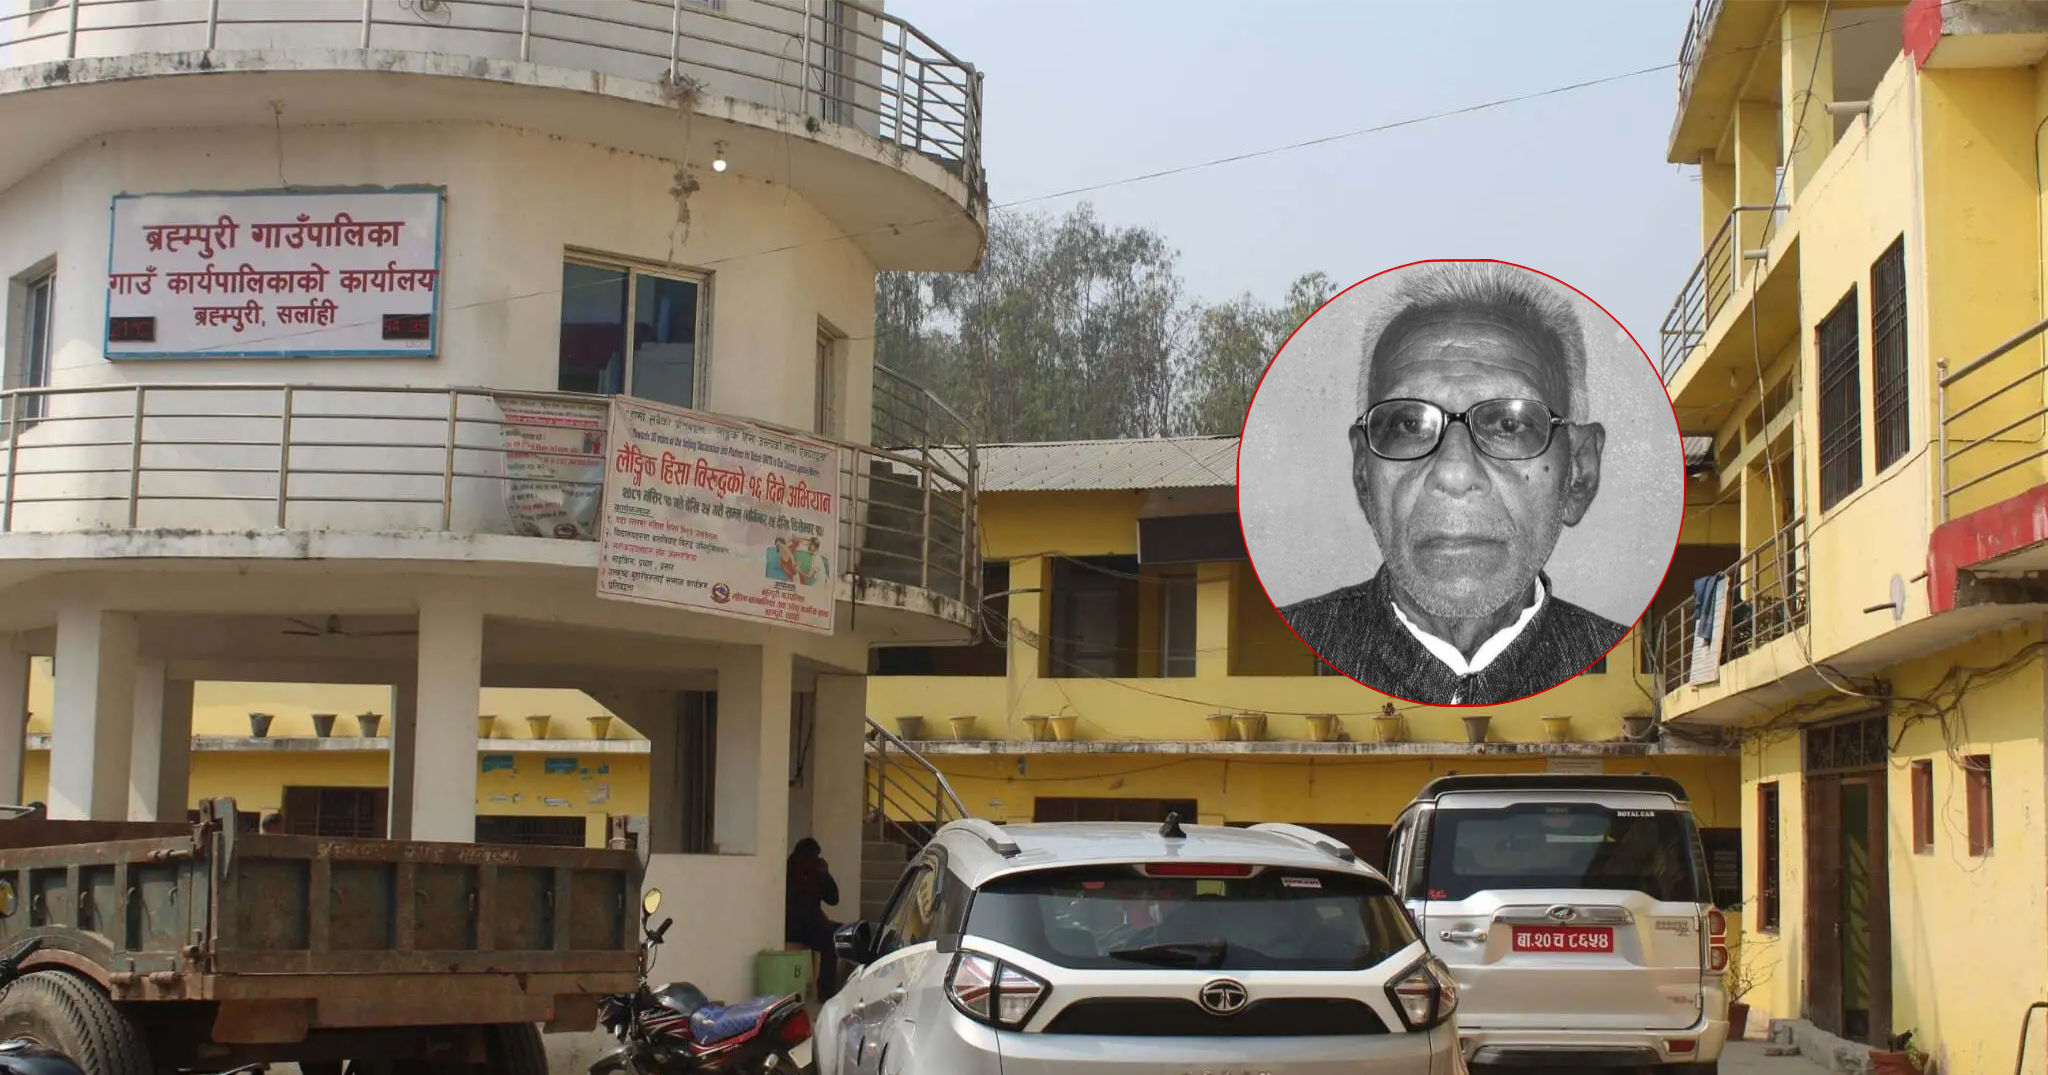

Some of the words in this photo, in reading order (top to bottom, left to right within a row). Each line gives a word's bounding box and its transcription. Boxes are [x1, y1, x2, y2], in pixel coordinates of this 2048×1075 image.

[251, 212, 405, 249] गाउँपालिका
[109, 265, 157, 294] गाउँ
[166, 262, 329, 294] कार्यपालिकाको
[339, 261, 439, 292] कार्यालय
[276, 298, 338, 326] सर्लाही
[660, 452, 692, 486] हिंसा
[748, 479, 763, 500] १६
[765, 472, 786, 504] दिने
[787, 481, 832, 514] अभियान
[1553, 932, 1565, 949] च
[1568, 932, 1609, 949] ८६५४
